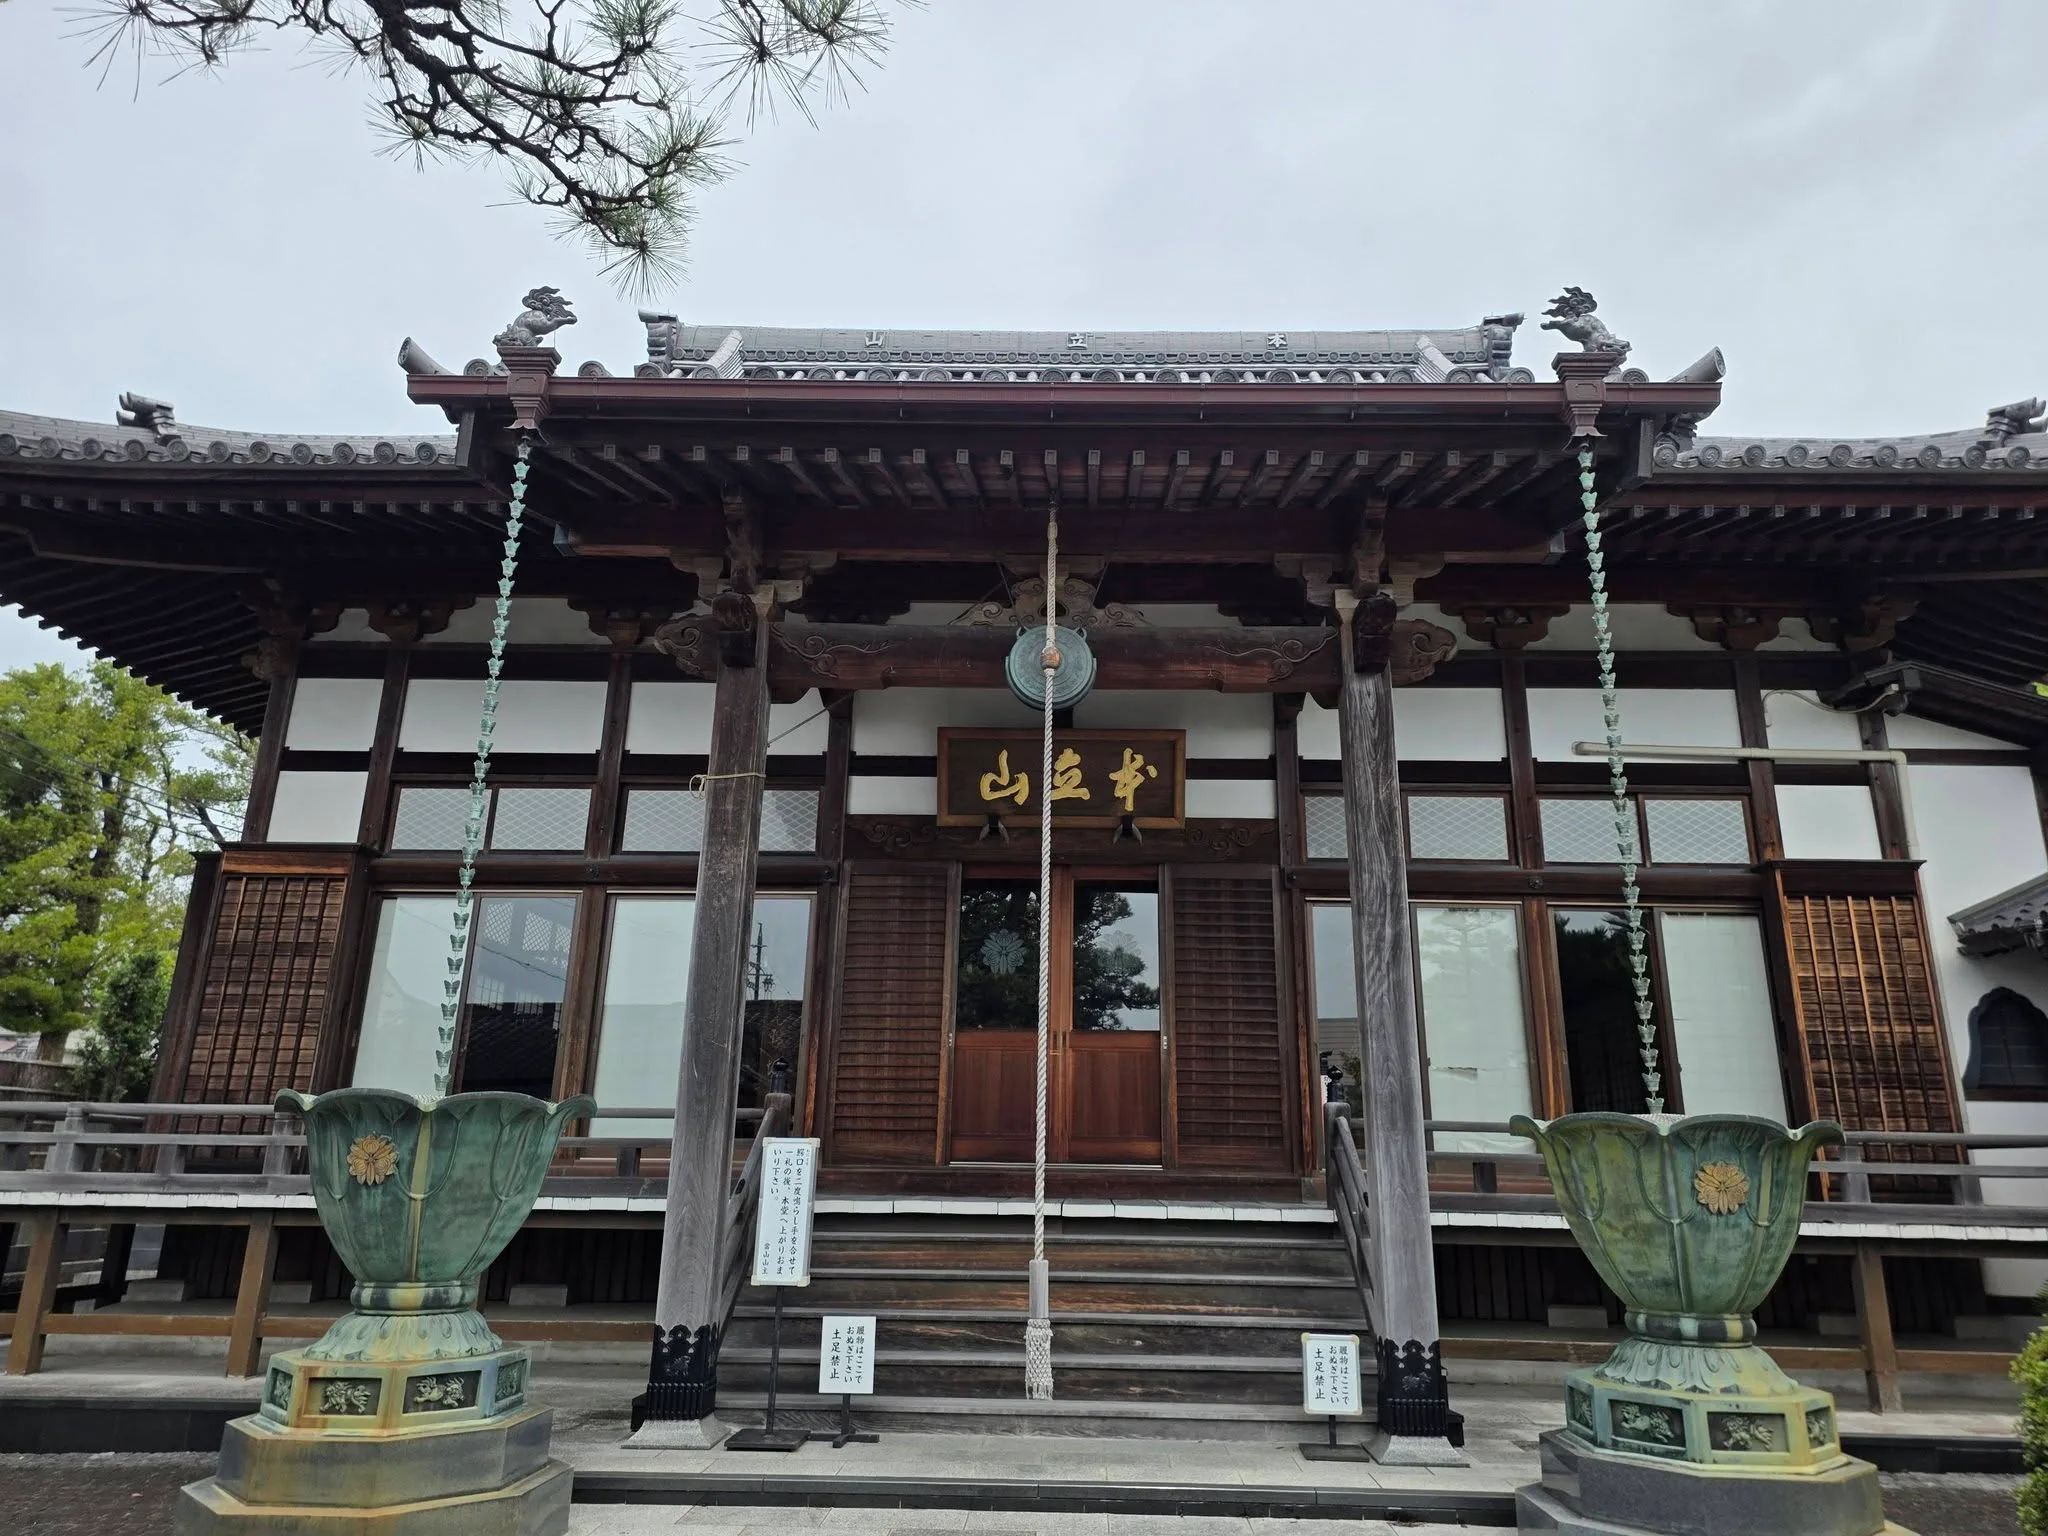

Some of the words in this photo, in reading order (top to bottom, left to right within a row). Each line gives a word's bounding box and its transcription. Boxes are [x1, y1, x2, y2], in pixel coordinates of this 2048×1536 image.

[830, 1328, 842, 1379] 土足禁止
[844, 1326, 855, 1383] おぬぎ下さい
[855, 1326, 865, 1384] 履物はここで
[1314, 1348, 1325, 1399] 土足禁止
[1329, 1346, 1340, 1403] おぬぎ下さい
[1339, 1346, 1350, 1405] 履物はここで
